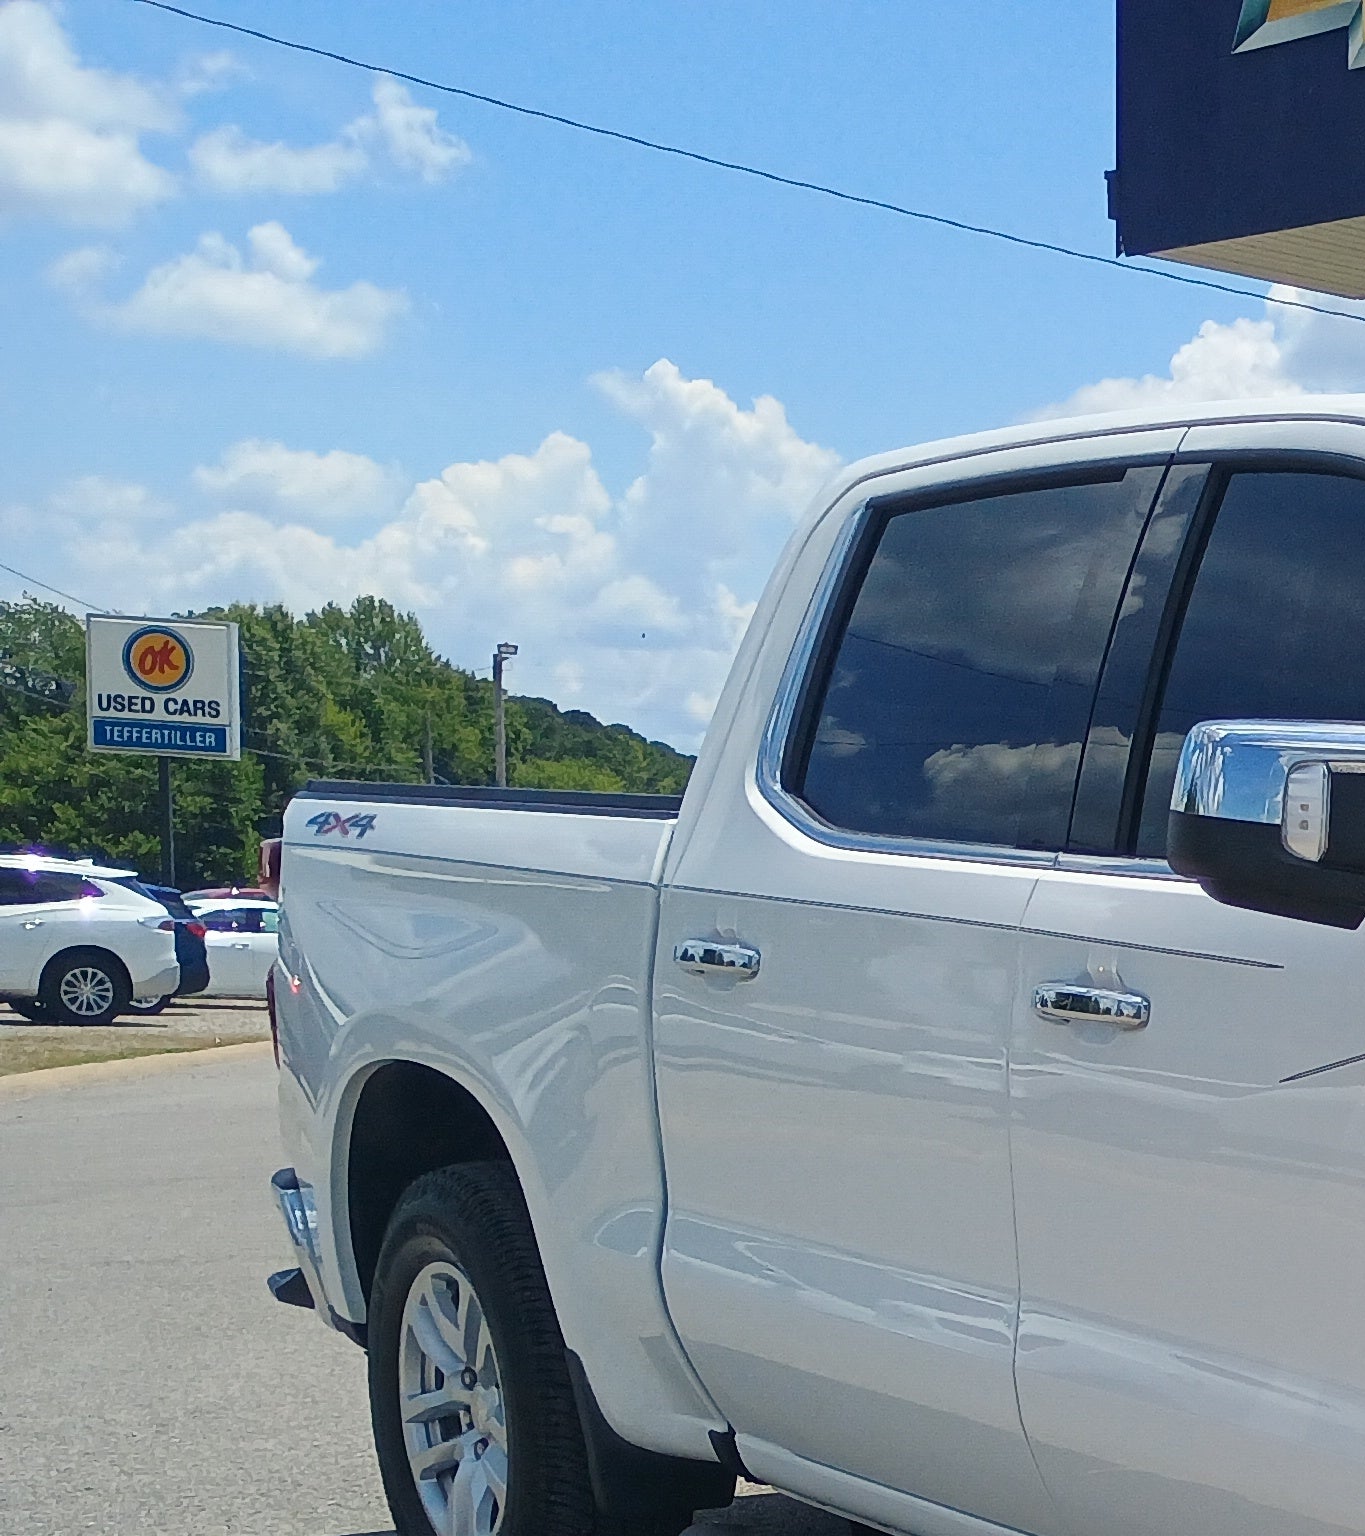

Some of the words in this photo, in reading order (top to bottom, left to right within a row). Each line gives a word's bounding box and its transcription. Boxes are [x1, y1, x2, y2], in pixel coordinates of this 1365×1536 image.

[139, 641, 179, 676] OK
[98, 695, 155, 714] USED
[165, 698, 221, 718] CARS
[106, 727, 216, 747] TEFFERTILLER
